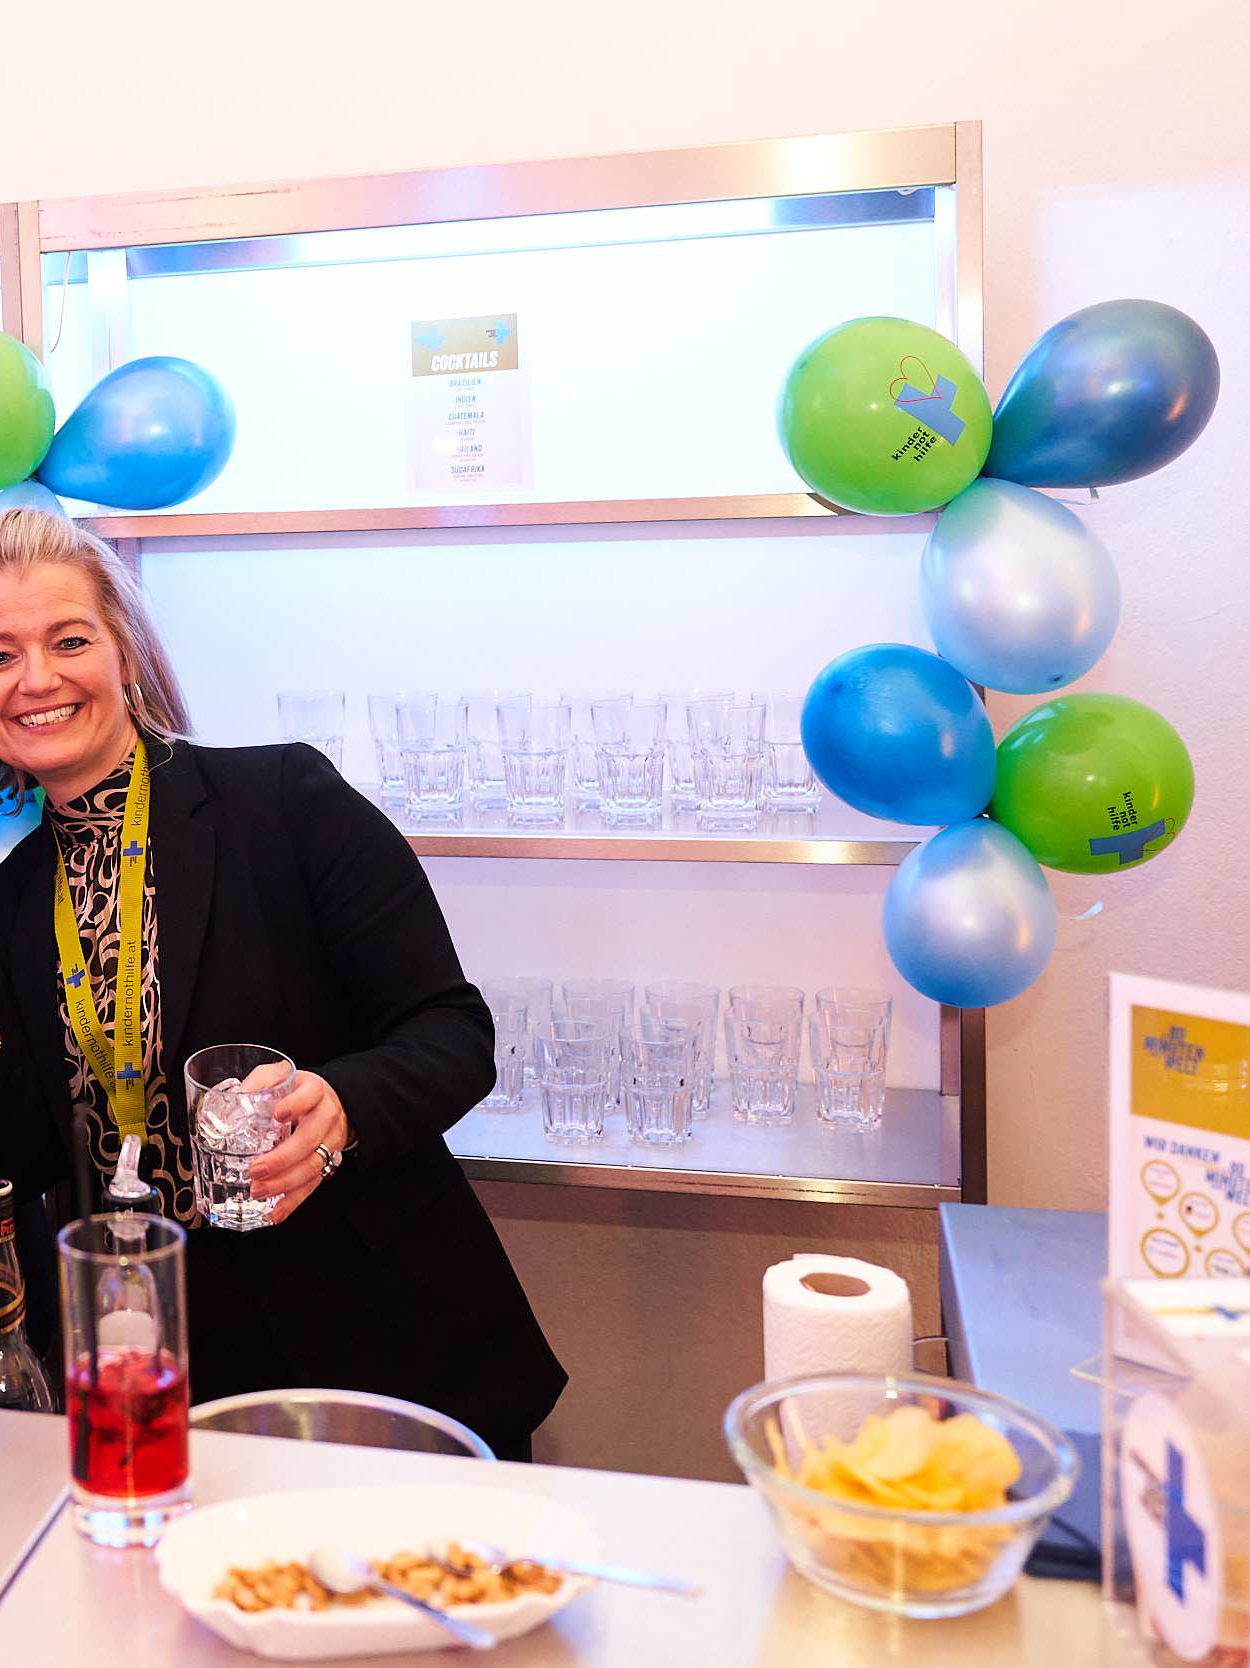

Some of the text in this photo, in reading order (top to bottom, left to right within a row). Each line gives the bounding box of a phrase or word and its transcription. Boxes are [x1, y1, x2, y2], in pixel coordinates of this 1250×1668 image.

[430, 351, 499, 372] COCKTAILS
[455, 395, 476, 404] INDIEN
[448, 411, 485, 420] GUATEMALA
[892, 427, 923, 461] kinder
[914, 431, 930, 450] not
[914, 437, 938, 462] hilfe
[1107, 806, 1120, 830] hilfe
[1123, 791, 1138, 825] kinder
[1119, 811, 1131, 828] not
[123, 941, 136, 1047] kindernothilfe.at
